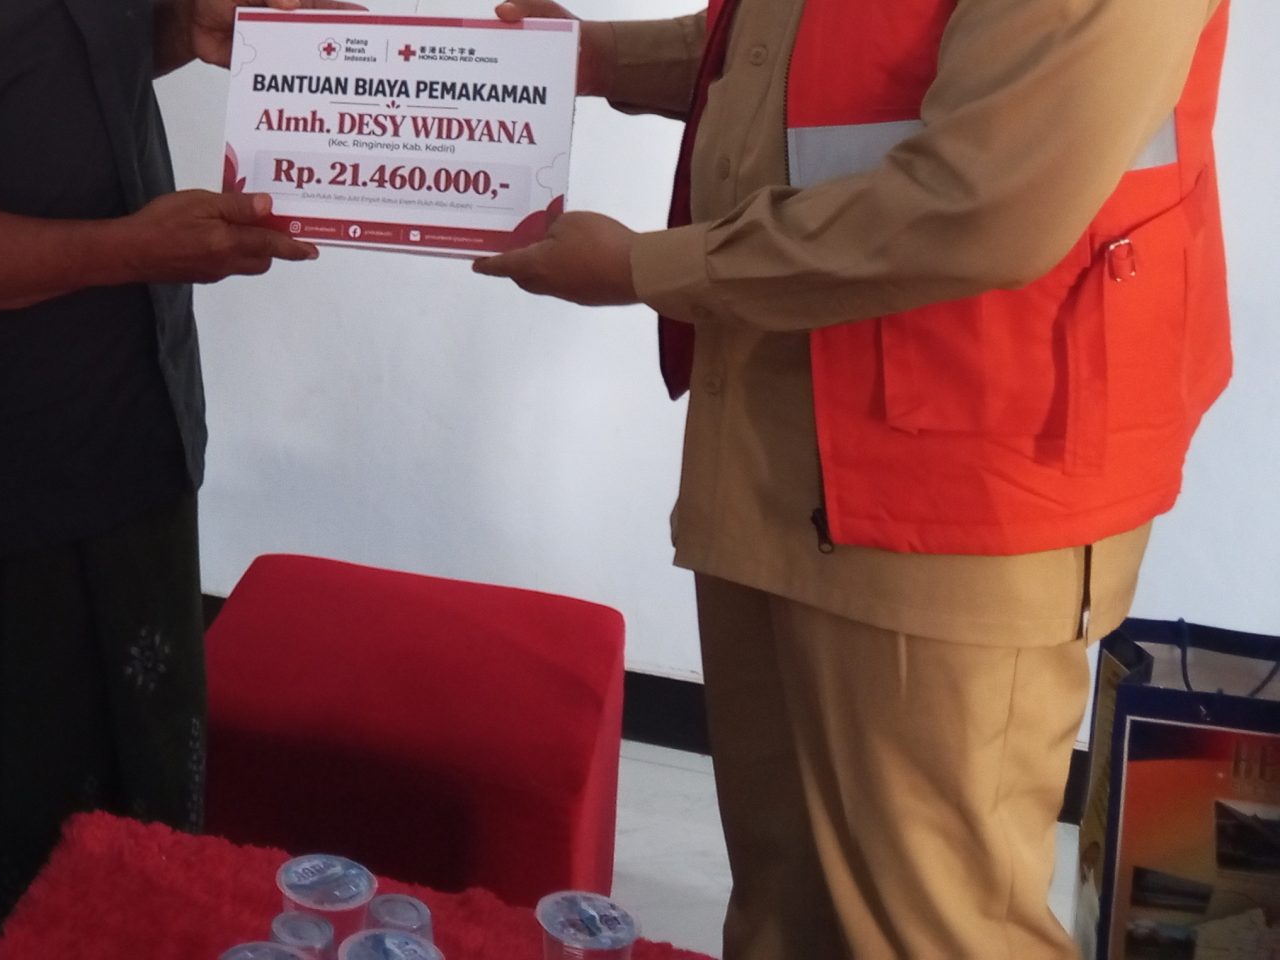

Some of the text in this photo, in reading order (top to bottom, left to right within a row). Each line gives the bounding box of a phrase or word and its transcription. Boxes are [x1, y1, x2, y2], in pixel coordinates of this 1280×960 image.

[345, 38, 368, 46] Palang
[345, 46, 366, 54] Merah
[252, 73, 547, 105] BANTUAN BIAYA PEMAKAMAN
[254, 108, 537, 145] Almh. DESY WIDYANA
[328, 138, 456, 154] (Kec. Ringinrejo Kab. Kediri)
[272, 158, 510, 200] Rp. 21.460.000,-
